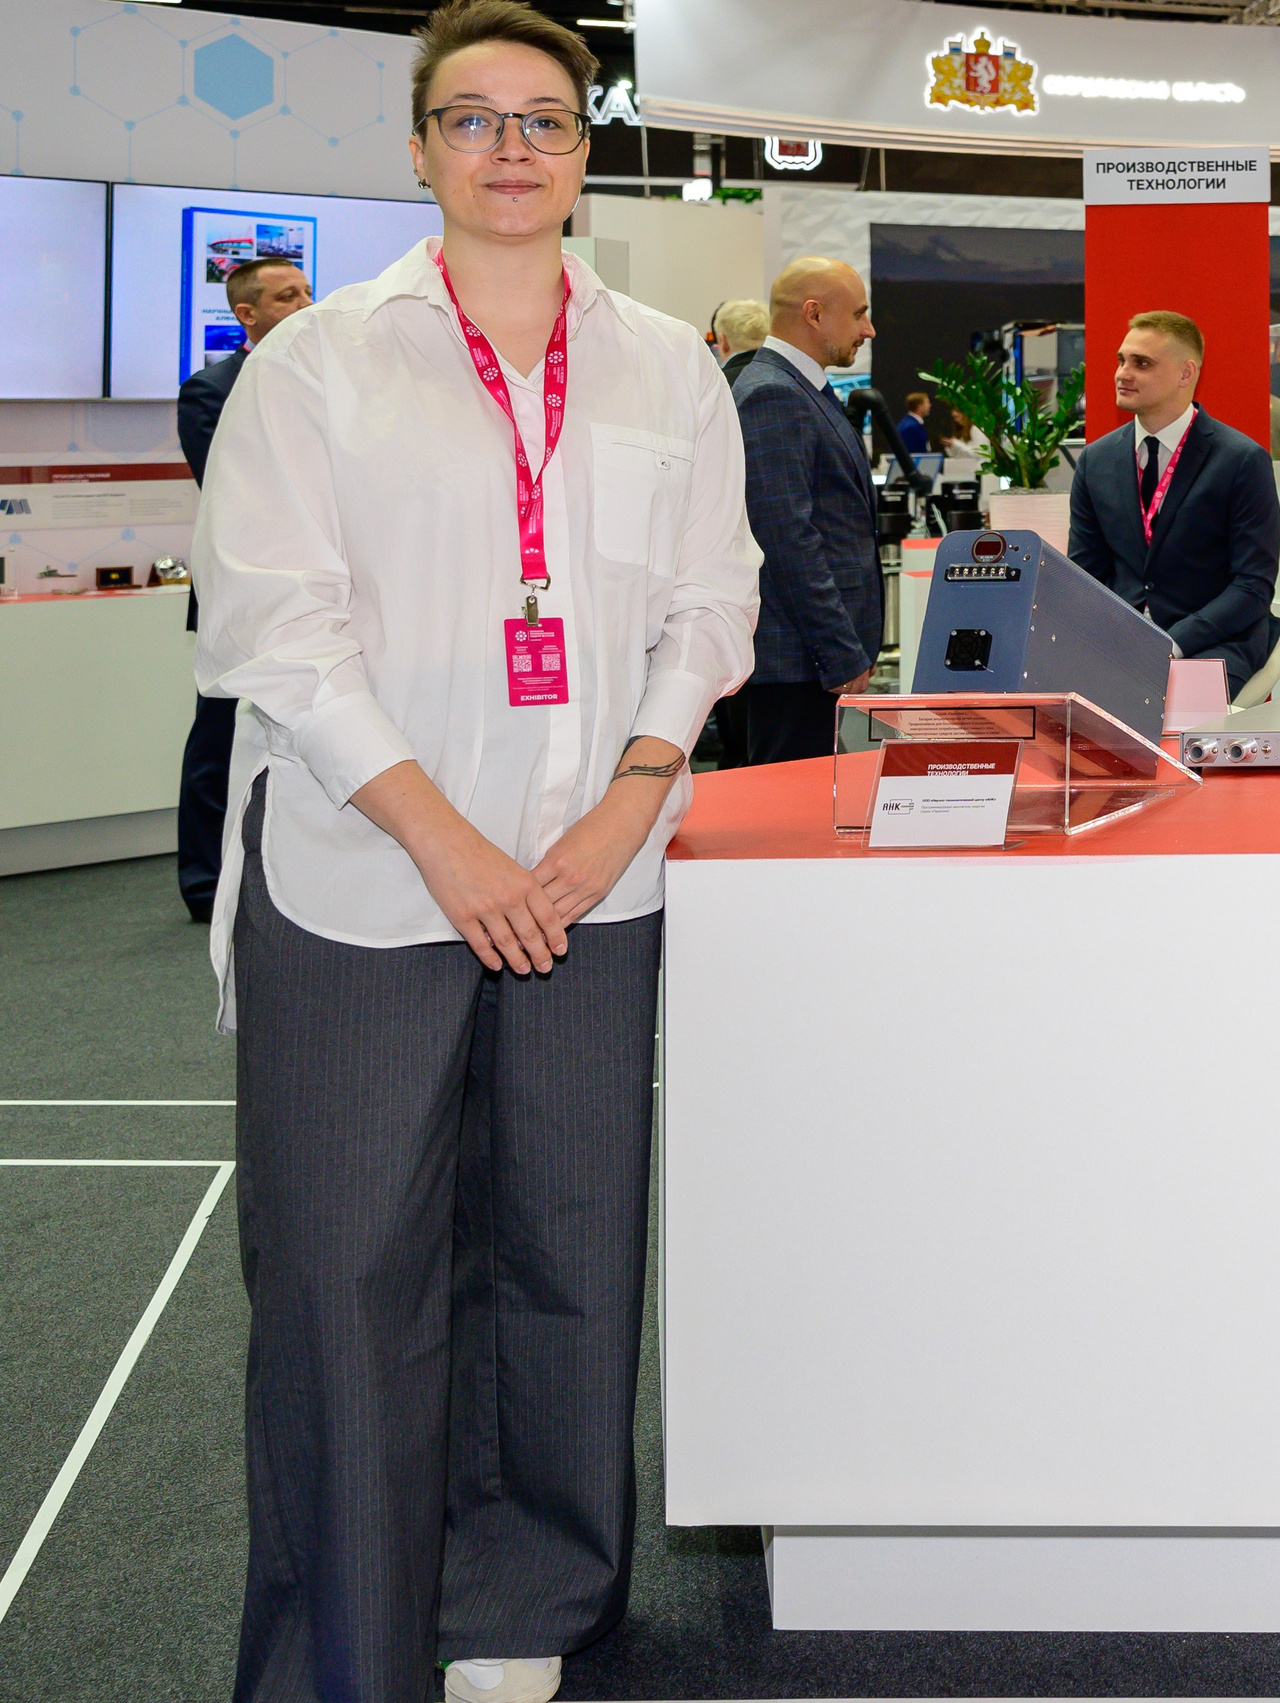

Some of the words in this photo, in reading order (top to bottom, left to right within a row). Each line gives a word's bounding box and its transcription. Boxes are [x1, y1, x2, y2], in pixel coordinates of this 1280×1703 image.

[1096, 160, 1257, 175] ПРОИЗВОДСТВЕННЫЕ
[1127, 178, 1226, 191] ТЕХНОЛОГИИ
[882, 803, 901, 811] АНК
